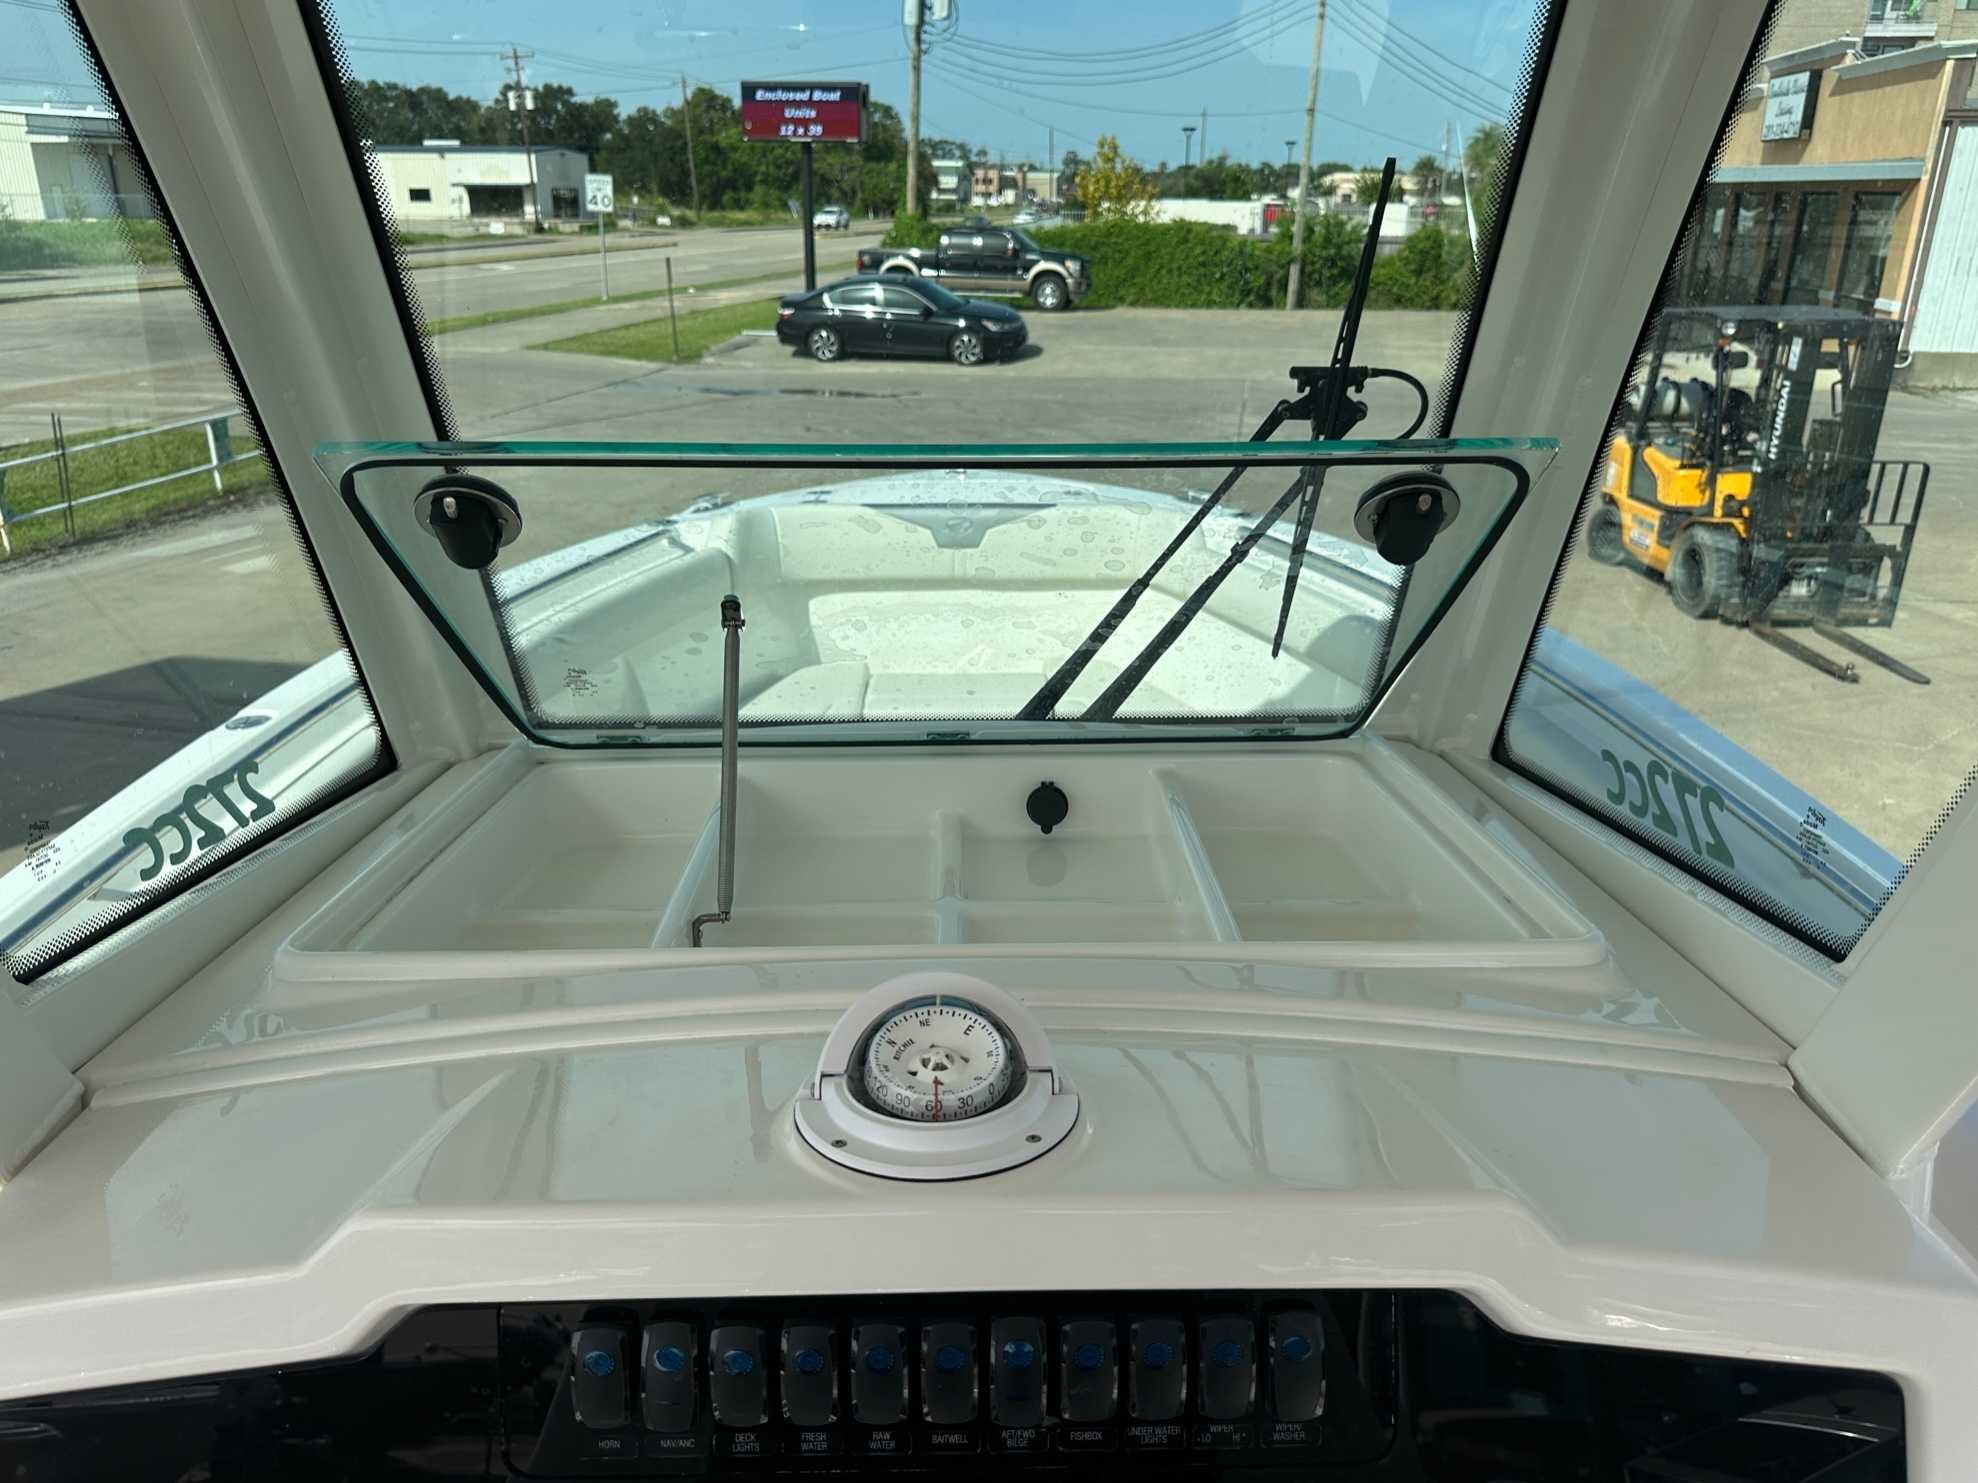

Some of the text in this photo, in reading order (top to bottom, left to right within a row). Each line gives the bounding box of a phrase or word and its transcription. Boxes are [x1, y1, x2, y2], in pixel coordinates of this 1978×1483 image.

[755, 88, 841, 101] Enclosed Boat
[784, 106, 817, 119] Units
[588, 194, 612, 208] 40
[1767, 380, 1791, 460] HYUNDAI
[919, 1018, 931, 1027] NE
[963, 1024, 975, 1036] E
[886, 1038, 897, 1048] N
[895, 1093, 911, 1108] 90
[958, 1094, 974, 1109] 30
[1128, 1425, 1181, 1436] UNDER WATER
[1210, 1423, 1235, 1433] WIPER
[735, 1432, 758, 1442] DECK
[801, 1432, 828, 1441] FRESH
[872, 1431, 892, 1440] RAW
[1070, 1431, 1104, 1441] FISHBOX
[1140, 1434, 1169, 1444] LIGHTS
[1272, 1431, 1305, 1441] WASHER
[598, 1439, 622, 1449] HORN
[732, 1442, 760, 1453] LIGHTS
[801, 1441, 828, 1451] WATER
[868, 1440, 896, 1450] WATER
